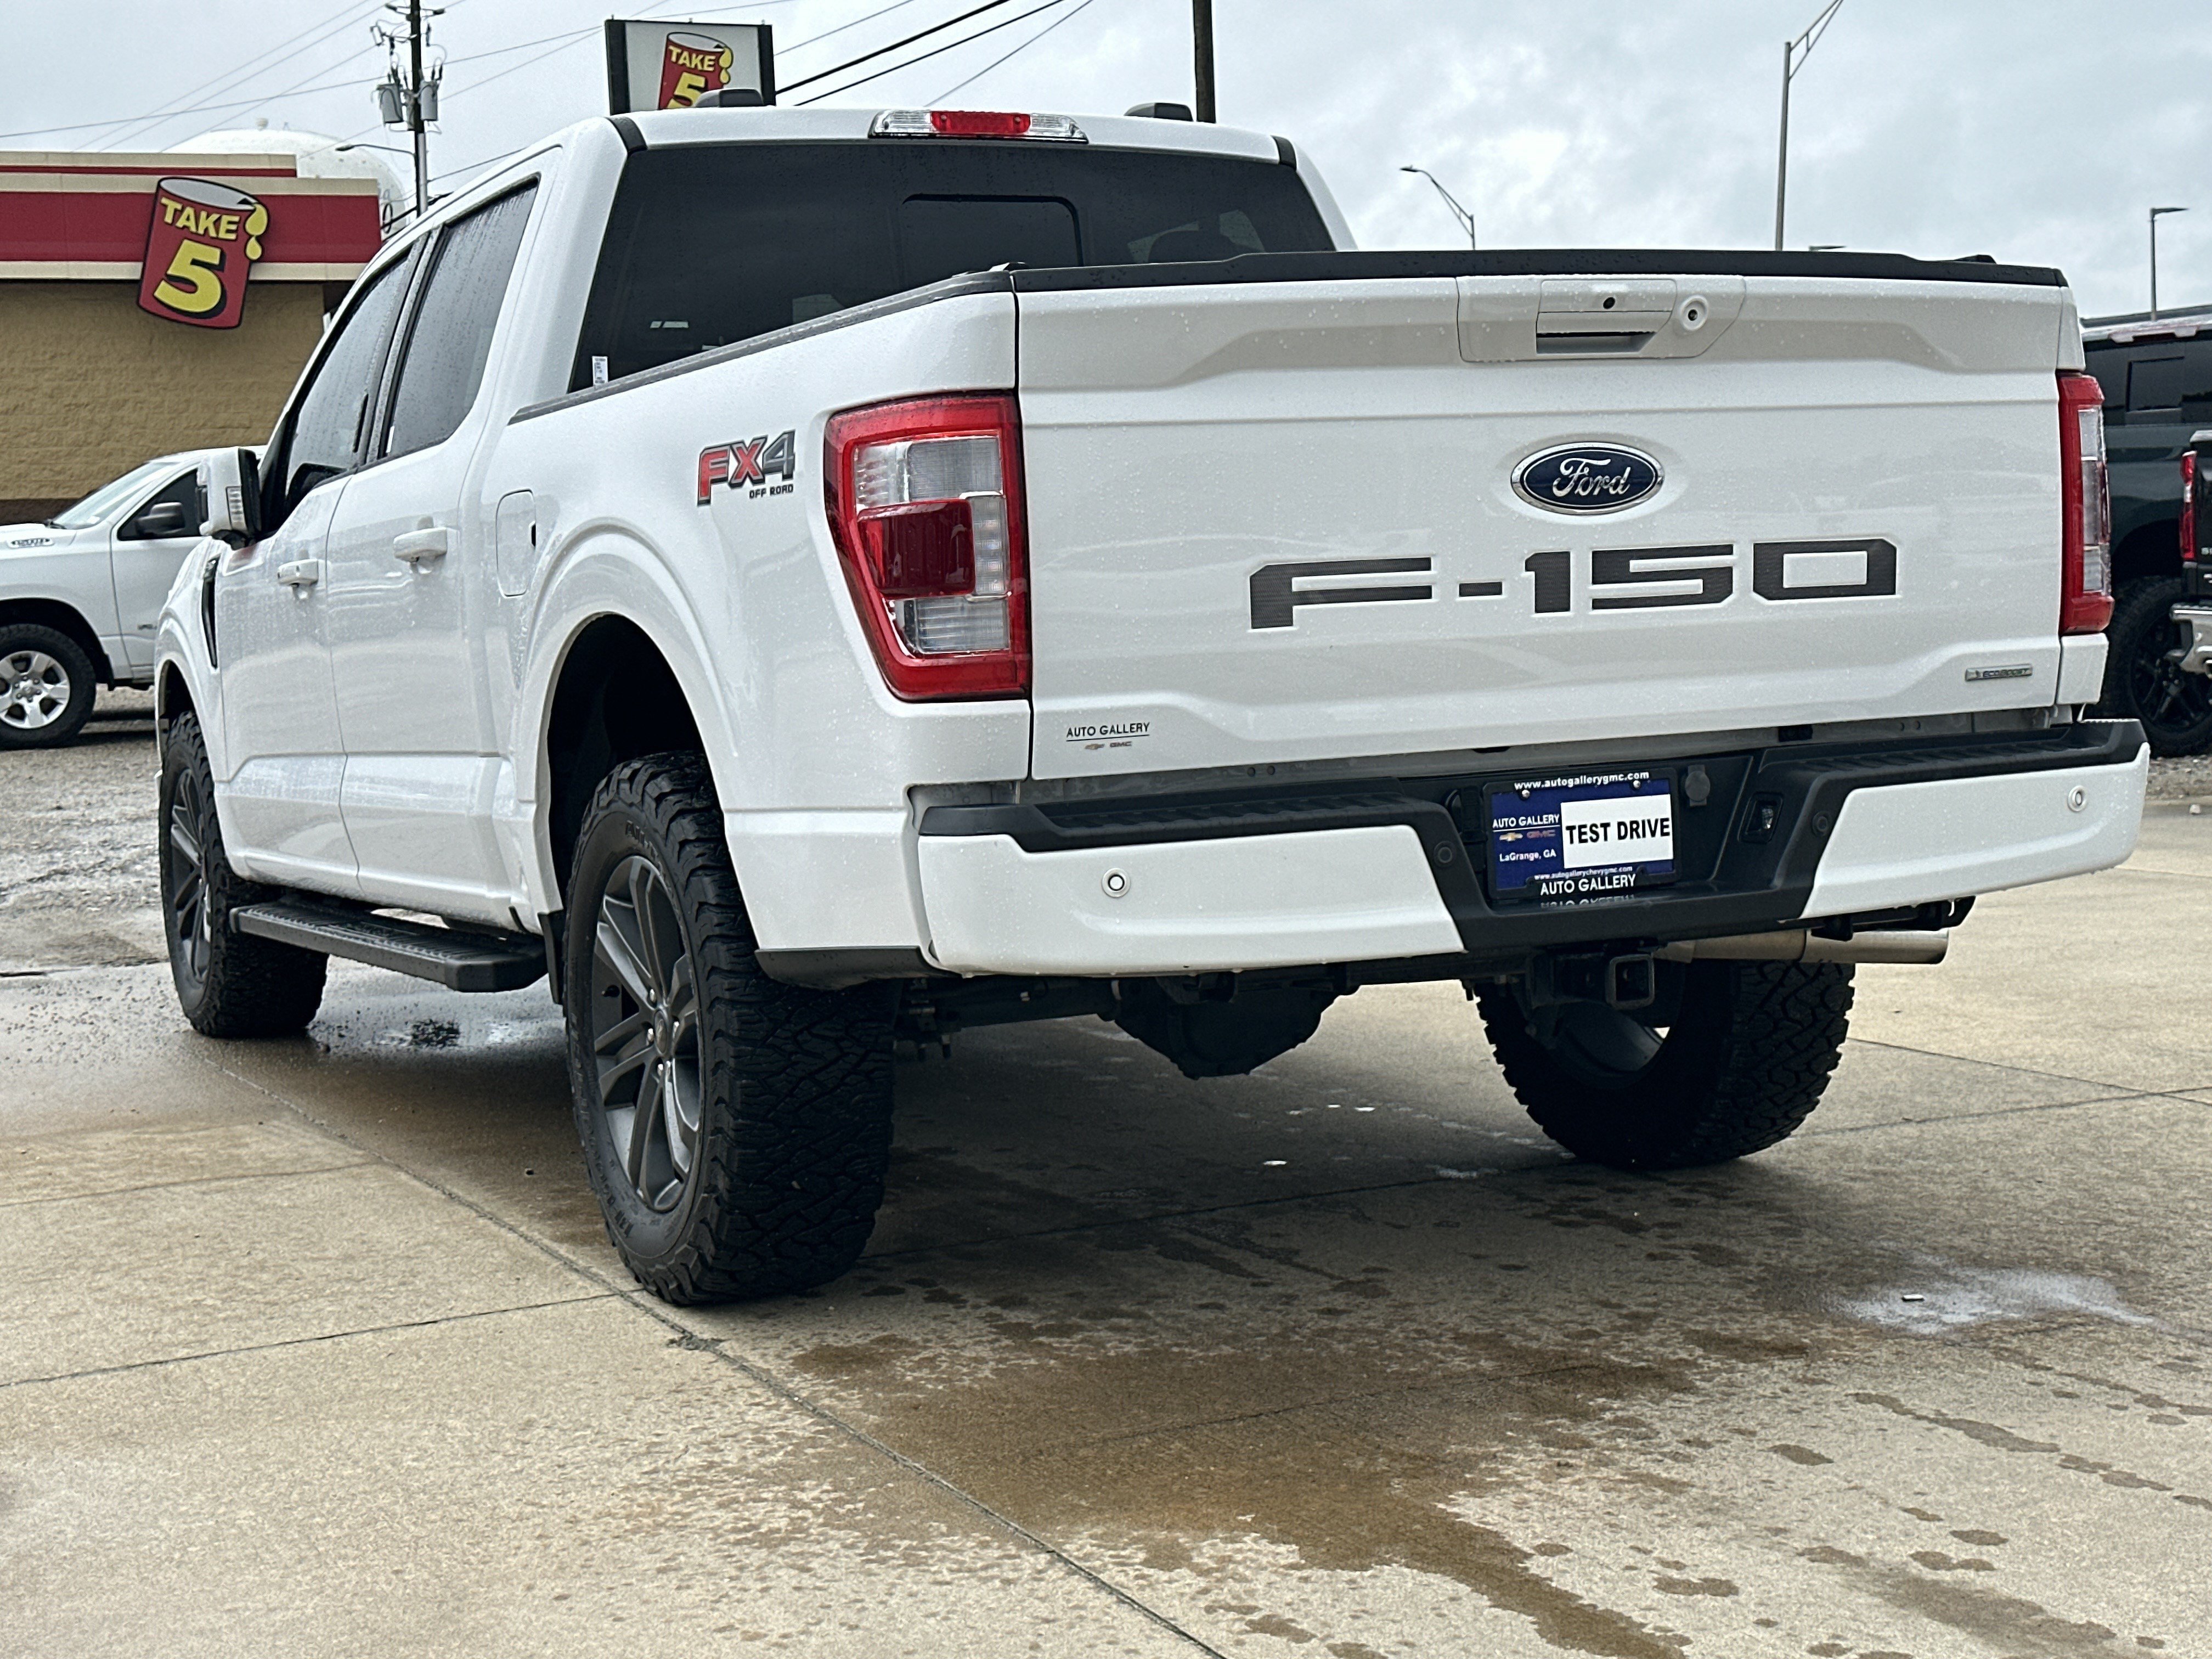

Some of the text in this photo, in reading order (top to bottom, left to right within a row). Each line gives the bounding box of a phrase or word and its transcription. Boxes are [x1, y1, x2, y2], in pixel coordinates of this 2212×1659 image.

[668, 45, 716, 72] TAKE
[667, 71, 707, 109] 5
[160, 196, 241, 240] TAKE
[153, 239, 223, 314] 5
[697, 429, 796, 507] FX4
[1552, 457, 1632, 497] Ford
[749, 483, 794, 500] OFF ROAD
[1249, 538, 1898, 629] F-150
[1066, 721, 1150, 738] AUTO GALLERY
[1514, 771, 1650, 789] www.autogallerygmc.com
[1492, 814, 1560, 829] AUTO GALLERY
[1565, 817, 1671, 845] TEST DRIVE
[1499, 848, 1557, 862] LaGrange, GA
[1540, 873, 1637, 896] AUTO GALLERY
